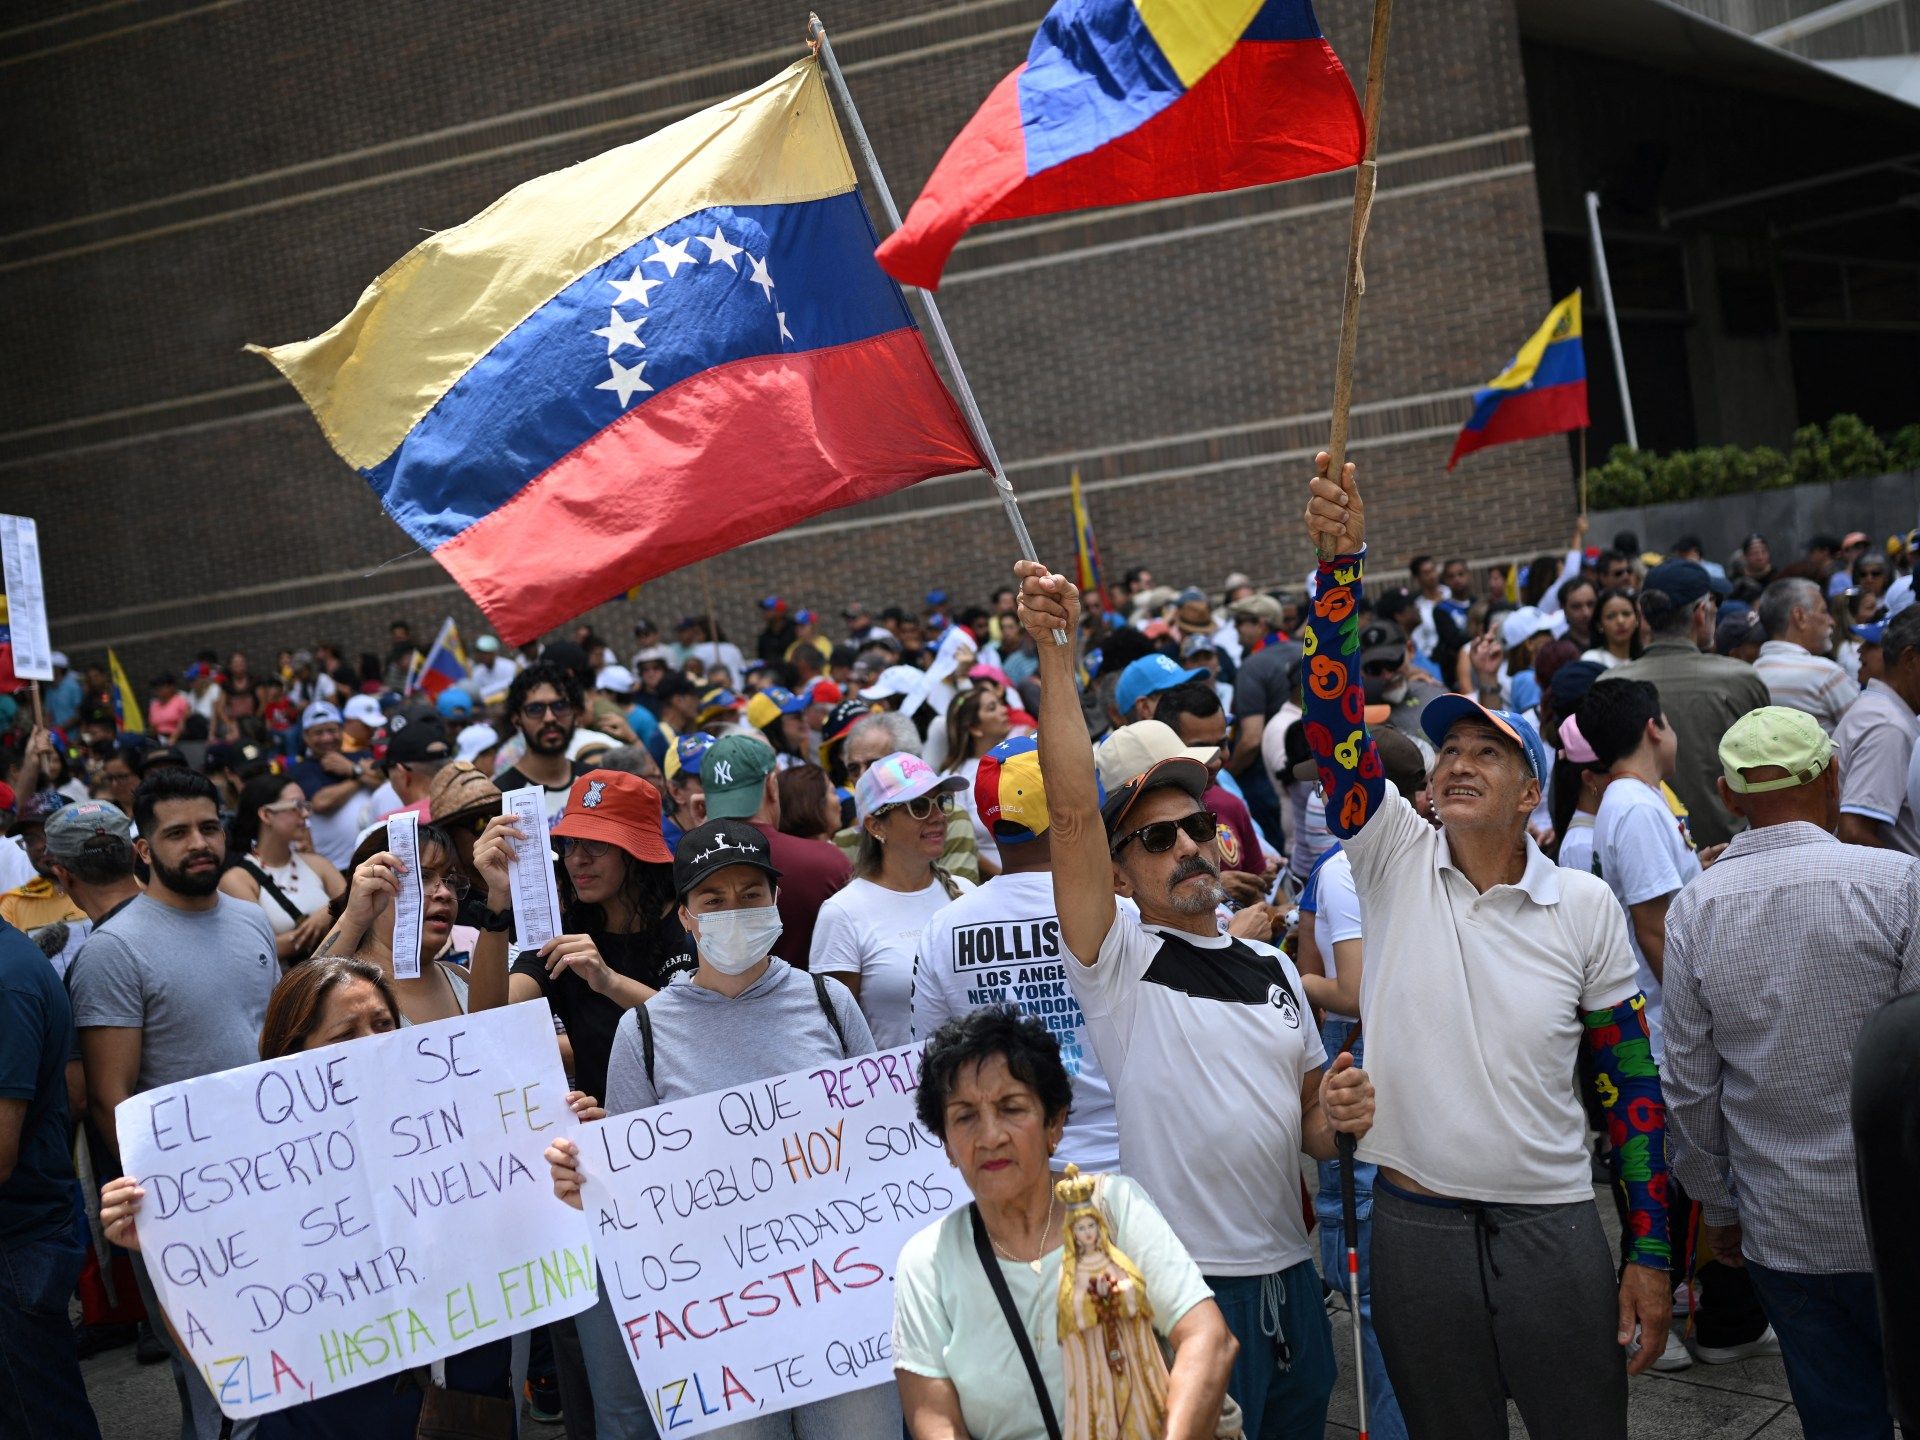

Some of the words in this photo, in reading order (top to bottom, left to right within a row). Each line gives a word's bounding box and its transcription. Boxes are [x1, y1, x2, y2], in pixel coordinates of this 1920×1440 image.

[713, 760, 733, 785] NY
[958, 921, 1060, 967] HOLLIS
[967, 988, 1007, 1005] NEW
[1012, 982, 1067, 1001] YORK
[976, 970, 1012, 988] LOS
[151, 1096, 212, 1151] EL
[255, 1056, 359, 1126] QUE
[416, 1031, 482, 1084] SE
[600, 1111, 693, 1173] LOS
[718, 1080, 801, 1138] QUE
[809, 1050, 925, 1110] REPRI
[139, 1119, 356, 1219] DESPERTÓ
[389, 1102, 464, 1158] SIN
[494, 1083, 554, 1135] FE
[598, 1197, 638, 1235] AL
[640, 1157, 774, 1225] PUEBLO
[781, 1117, 851, 1185] HOY,
[865, 1121, 943, 1162] SON
[160, 1230, 259, 1289] QUE
[299, 1196, 371, 1247] SE
[393, 1153, 535, 1219] VUELVA
[614, 1243, 702, 1301] LOS
[724, 1172, 953, 1269] VERDADEROS
[184, 1309, 214, 1349] A
[237, 1246, 426, 1334] DORMIR.
[320, 1309, 435, 1383] HASTA
[446, 1282, 498, 1341] EL
[498, 1244, 598, 1321] FINAL
[621, 1246, 895, 1361] FACISTAS.
[644, 1365, 765, 1432] VZLA,
[754, 1354, 813, 1394] TE
